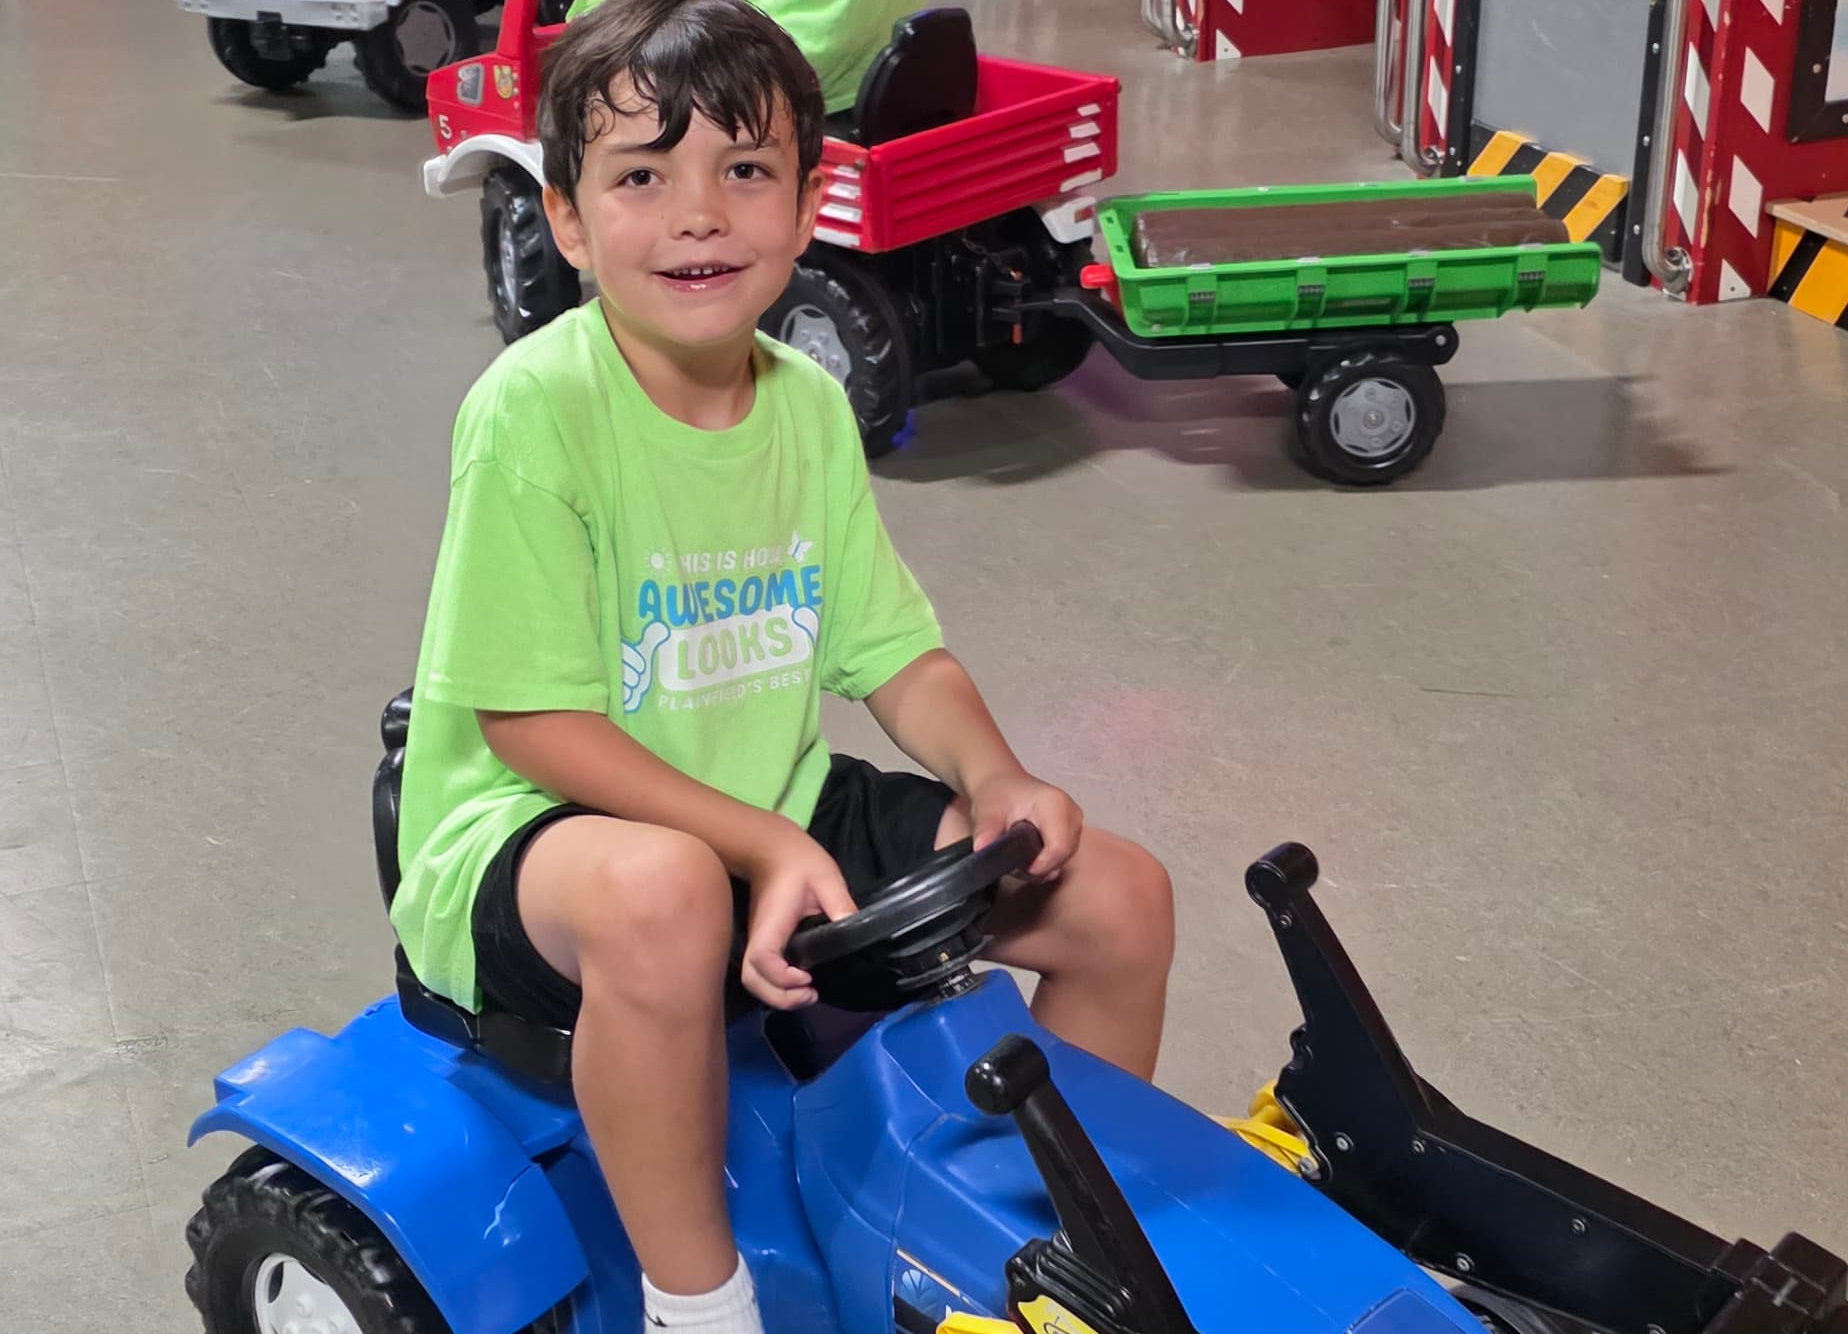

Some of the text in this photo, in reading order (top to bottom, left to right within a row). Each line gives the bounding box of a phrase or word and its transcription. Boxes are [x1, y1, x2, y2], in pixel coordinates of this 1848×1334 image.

[438, 114, 453, 140] 5
[678, 545, 786, 573] HIS IS HO
[638, 564, 824, 627] AWESOME
[677, 617, 793, 681] LOOKS
